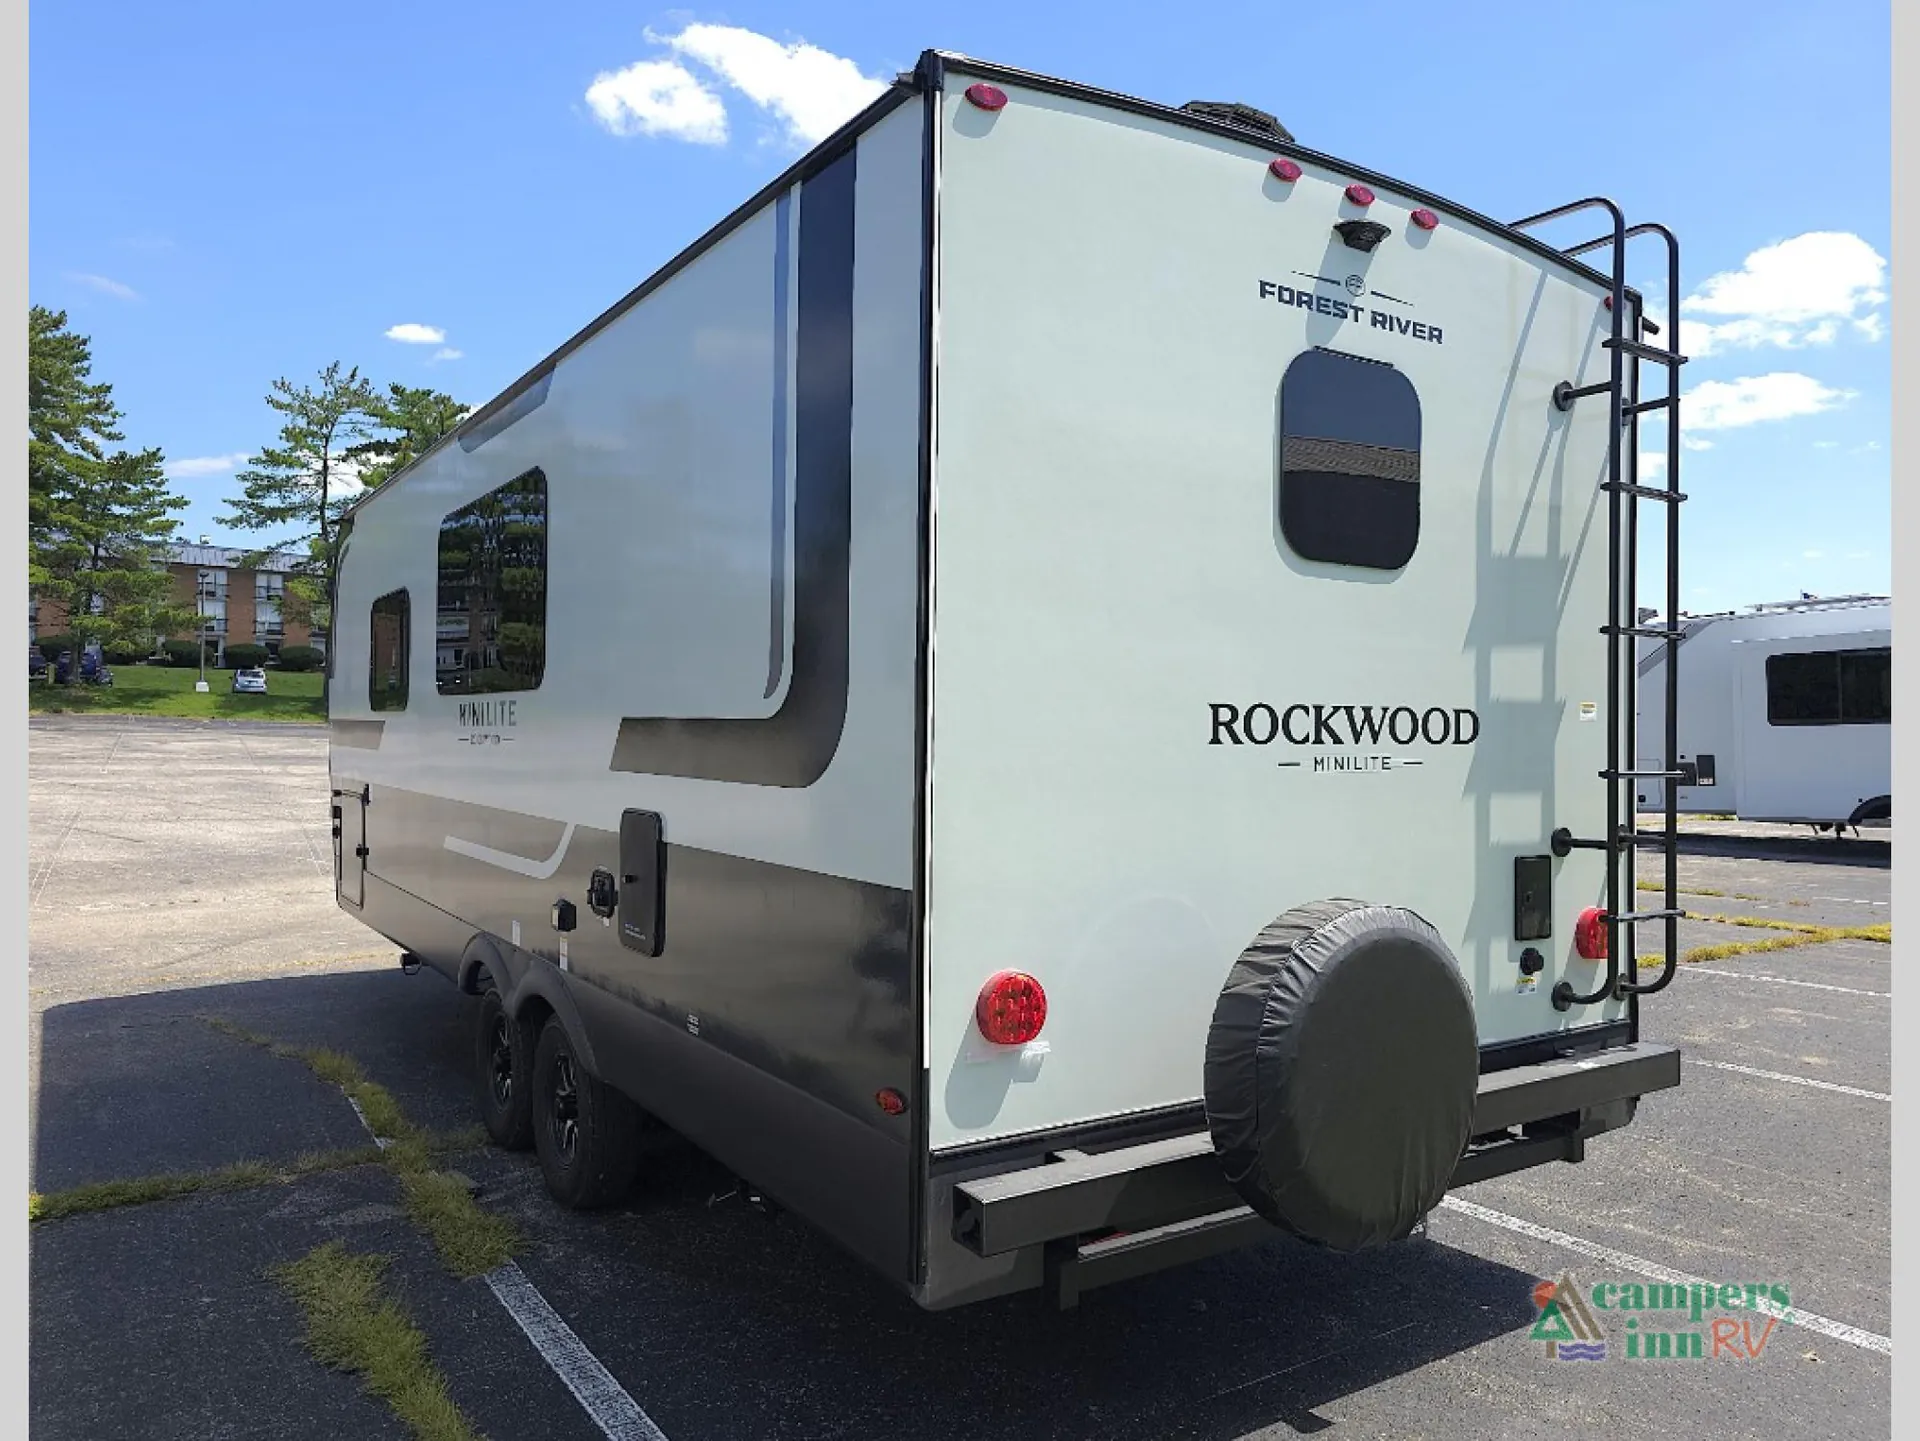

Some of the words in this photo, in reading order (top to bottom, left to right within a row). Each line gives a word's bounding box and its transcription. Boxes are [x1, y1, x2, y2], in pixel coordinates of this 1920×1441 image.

[1258, 279, 1364, 323] FOREST
[1370, 310, 1443, 344] RIVER
[1208, 702, 1480, 745] ROCKWOOD
[1314, 756, 1391, 772] MINILITE
